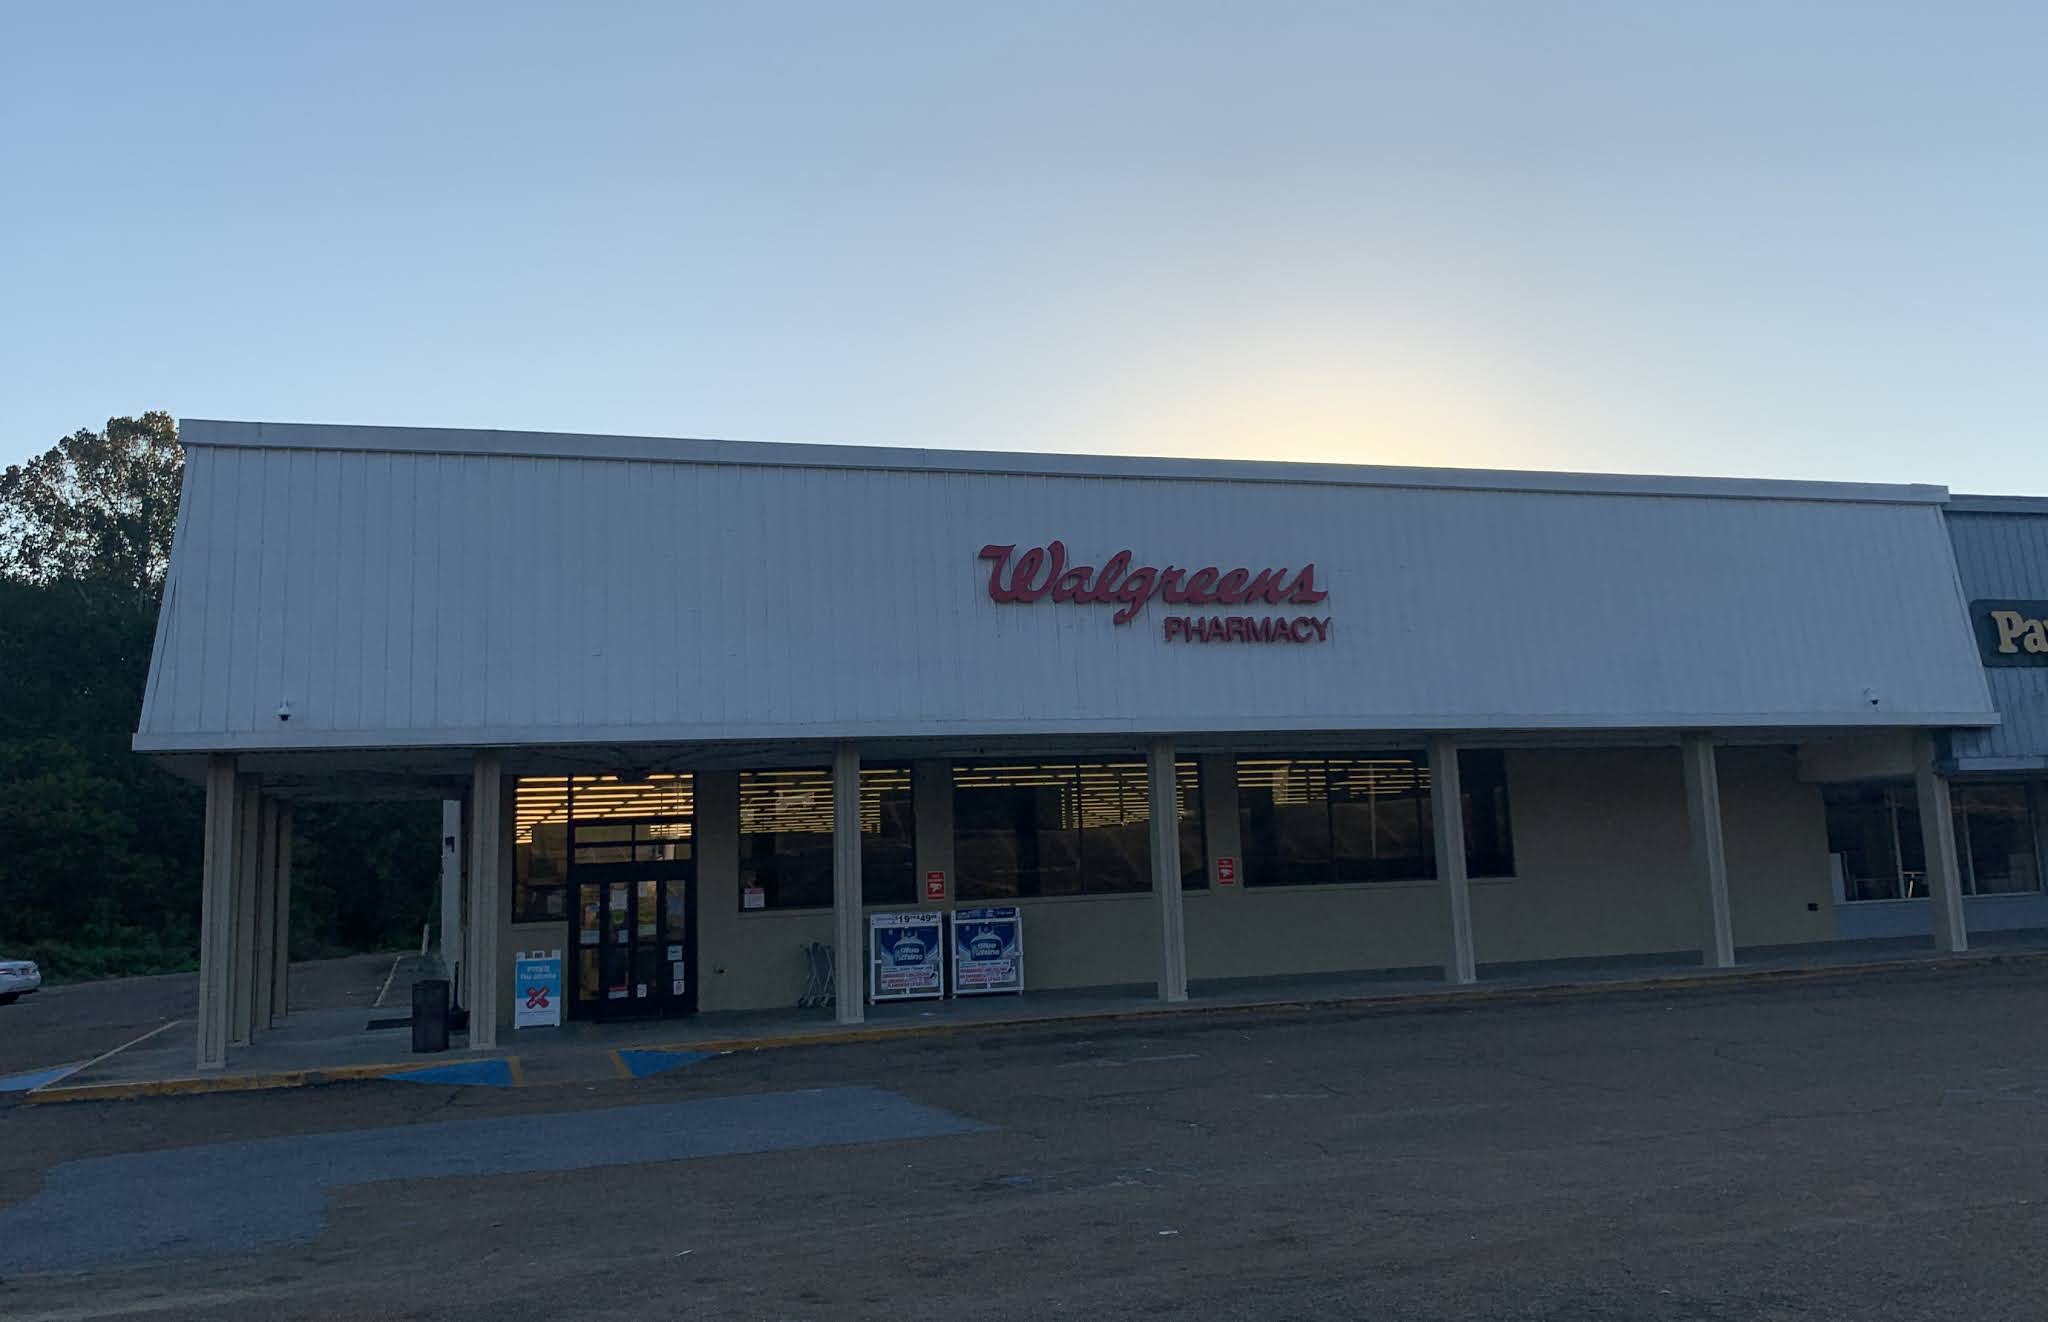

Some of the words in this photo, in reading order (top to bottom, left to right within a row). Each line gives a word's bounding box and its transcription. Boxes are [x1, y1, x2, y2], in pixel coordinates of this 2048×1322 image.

[979, 541, 1328, 624] Walgreens
[1163, 616, 1331, 643] PHARMACY
[1991, 611, 2048, 653] Pa
